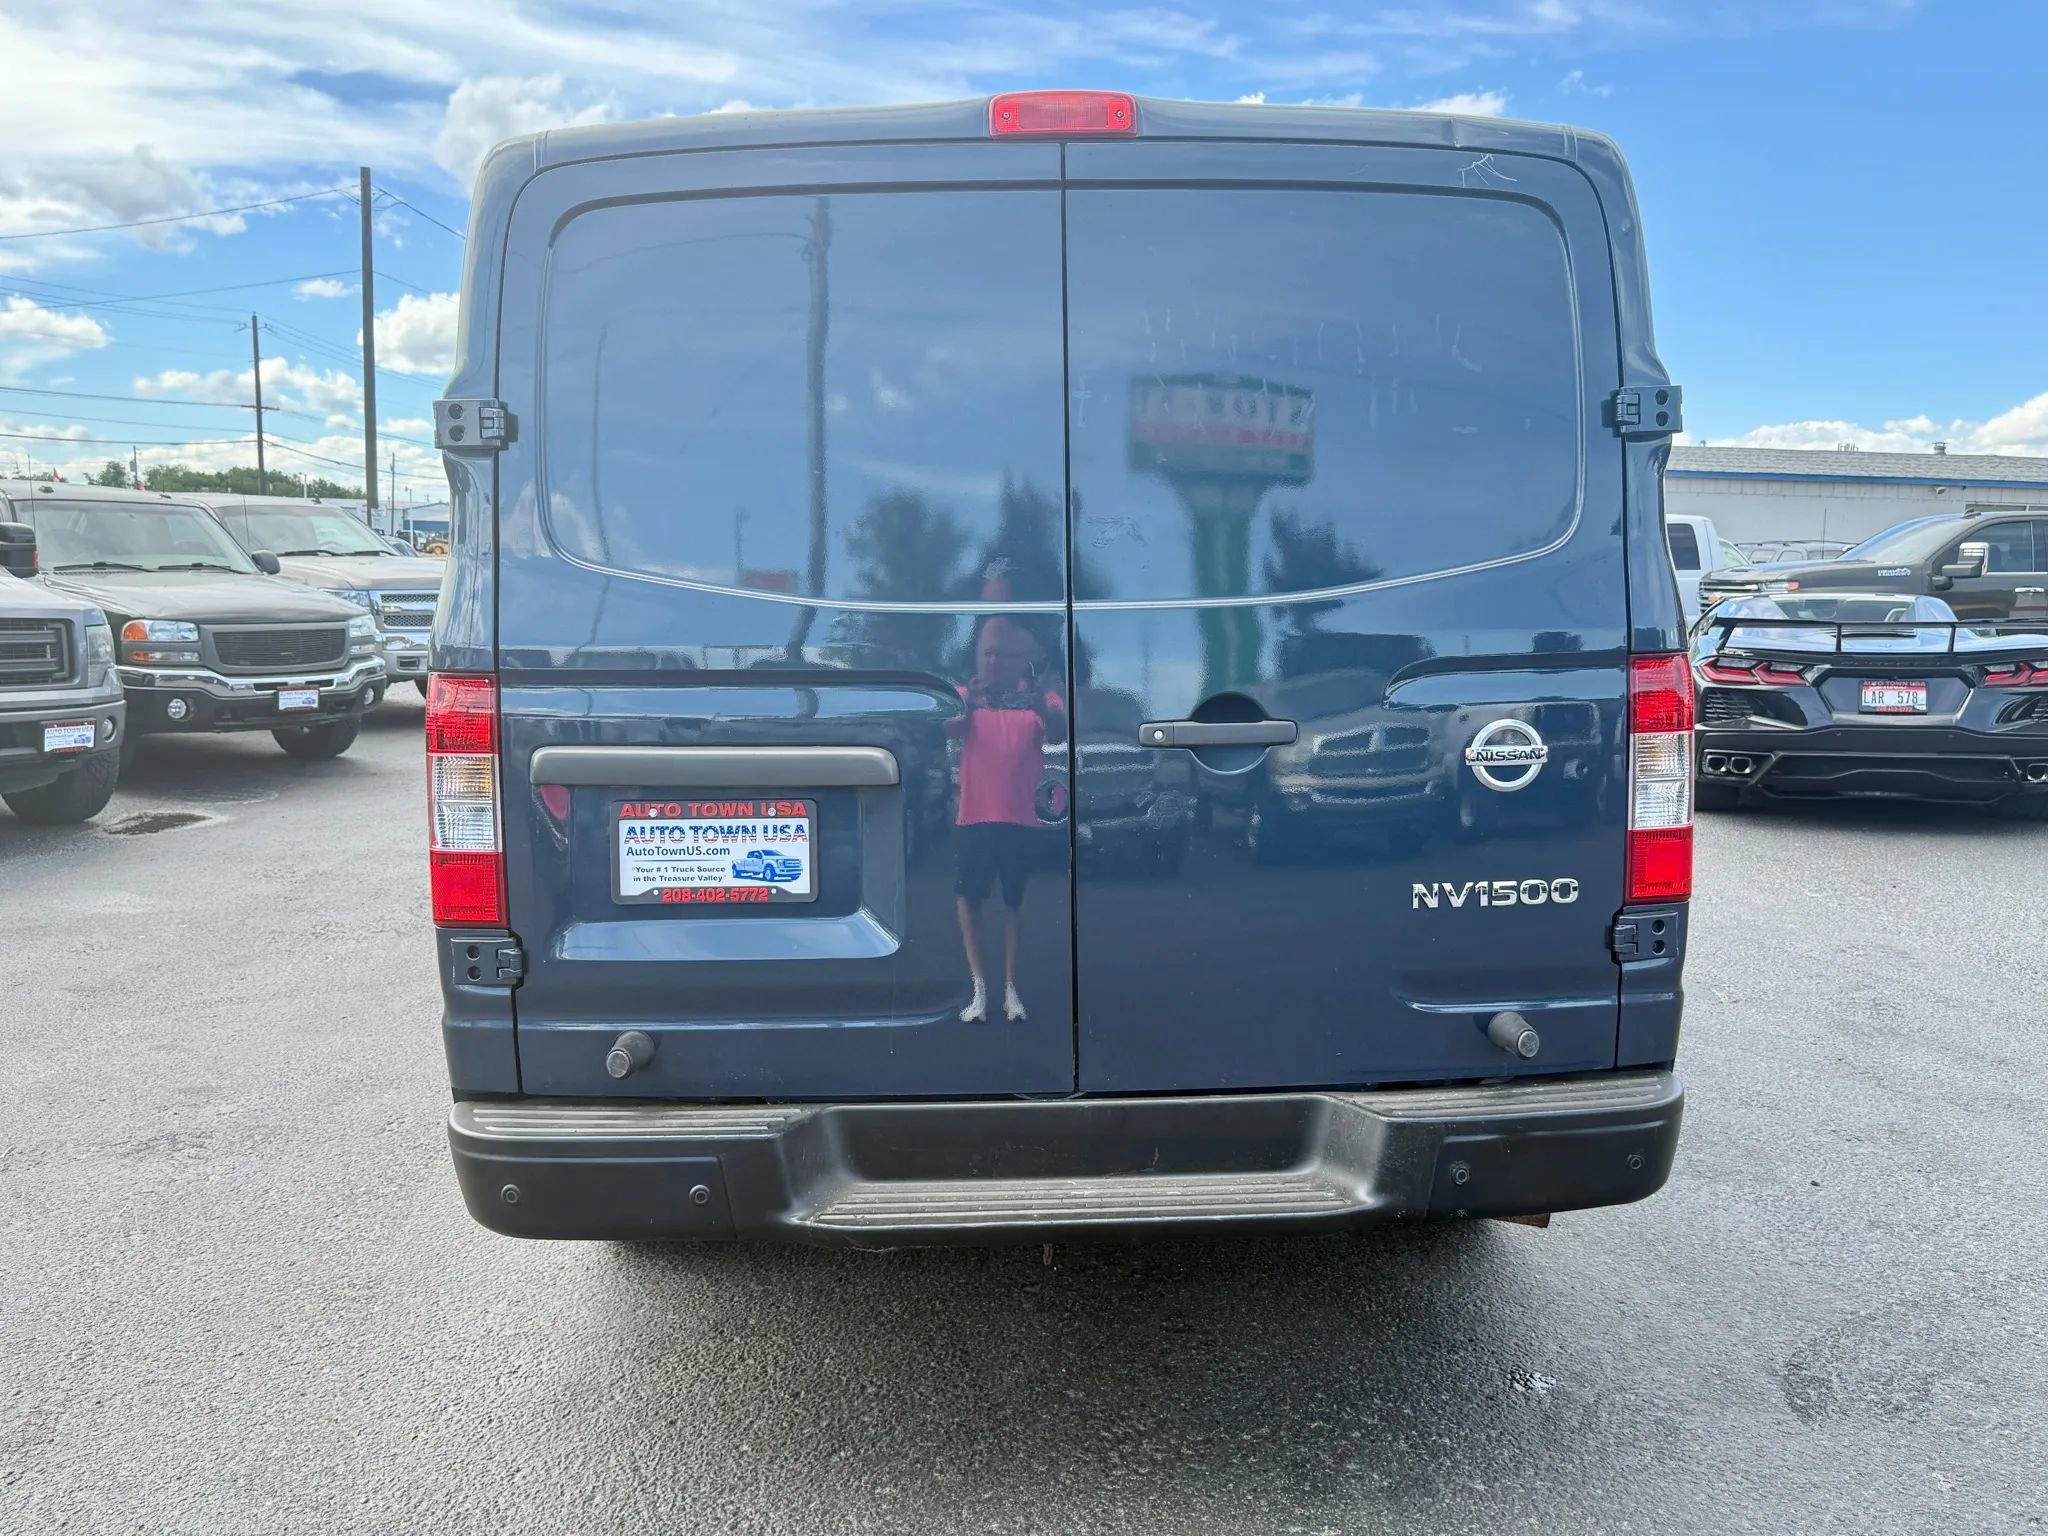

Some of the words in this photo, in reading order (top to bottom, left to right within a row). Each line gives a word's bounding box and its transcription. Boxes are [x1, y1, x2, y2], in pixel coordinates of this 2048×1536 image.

[1863, 691, 1885, 704] LAR
[1897, 691, 1918, 704] 578
[1475, 748, 1541, 762] NISSAN
[620, 802, 682, 818] AUTO
[687, 801, 754, 817] TOWN
[760, 801, 807, 817] USA
[624, 825, 686, 845] AUTO
[689, 824, 758, 844] TOWN
[763, 823, 809, 843] USA
[626, 845, 731, 857] AutoTownUS.com
[697, 865, 726, 873] Source
[662, 887, 769, 903] 208-402-5772
[1411, 878, 1579, 909] NV1500
